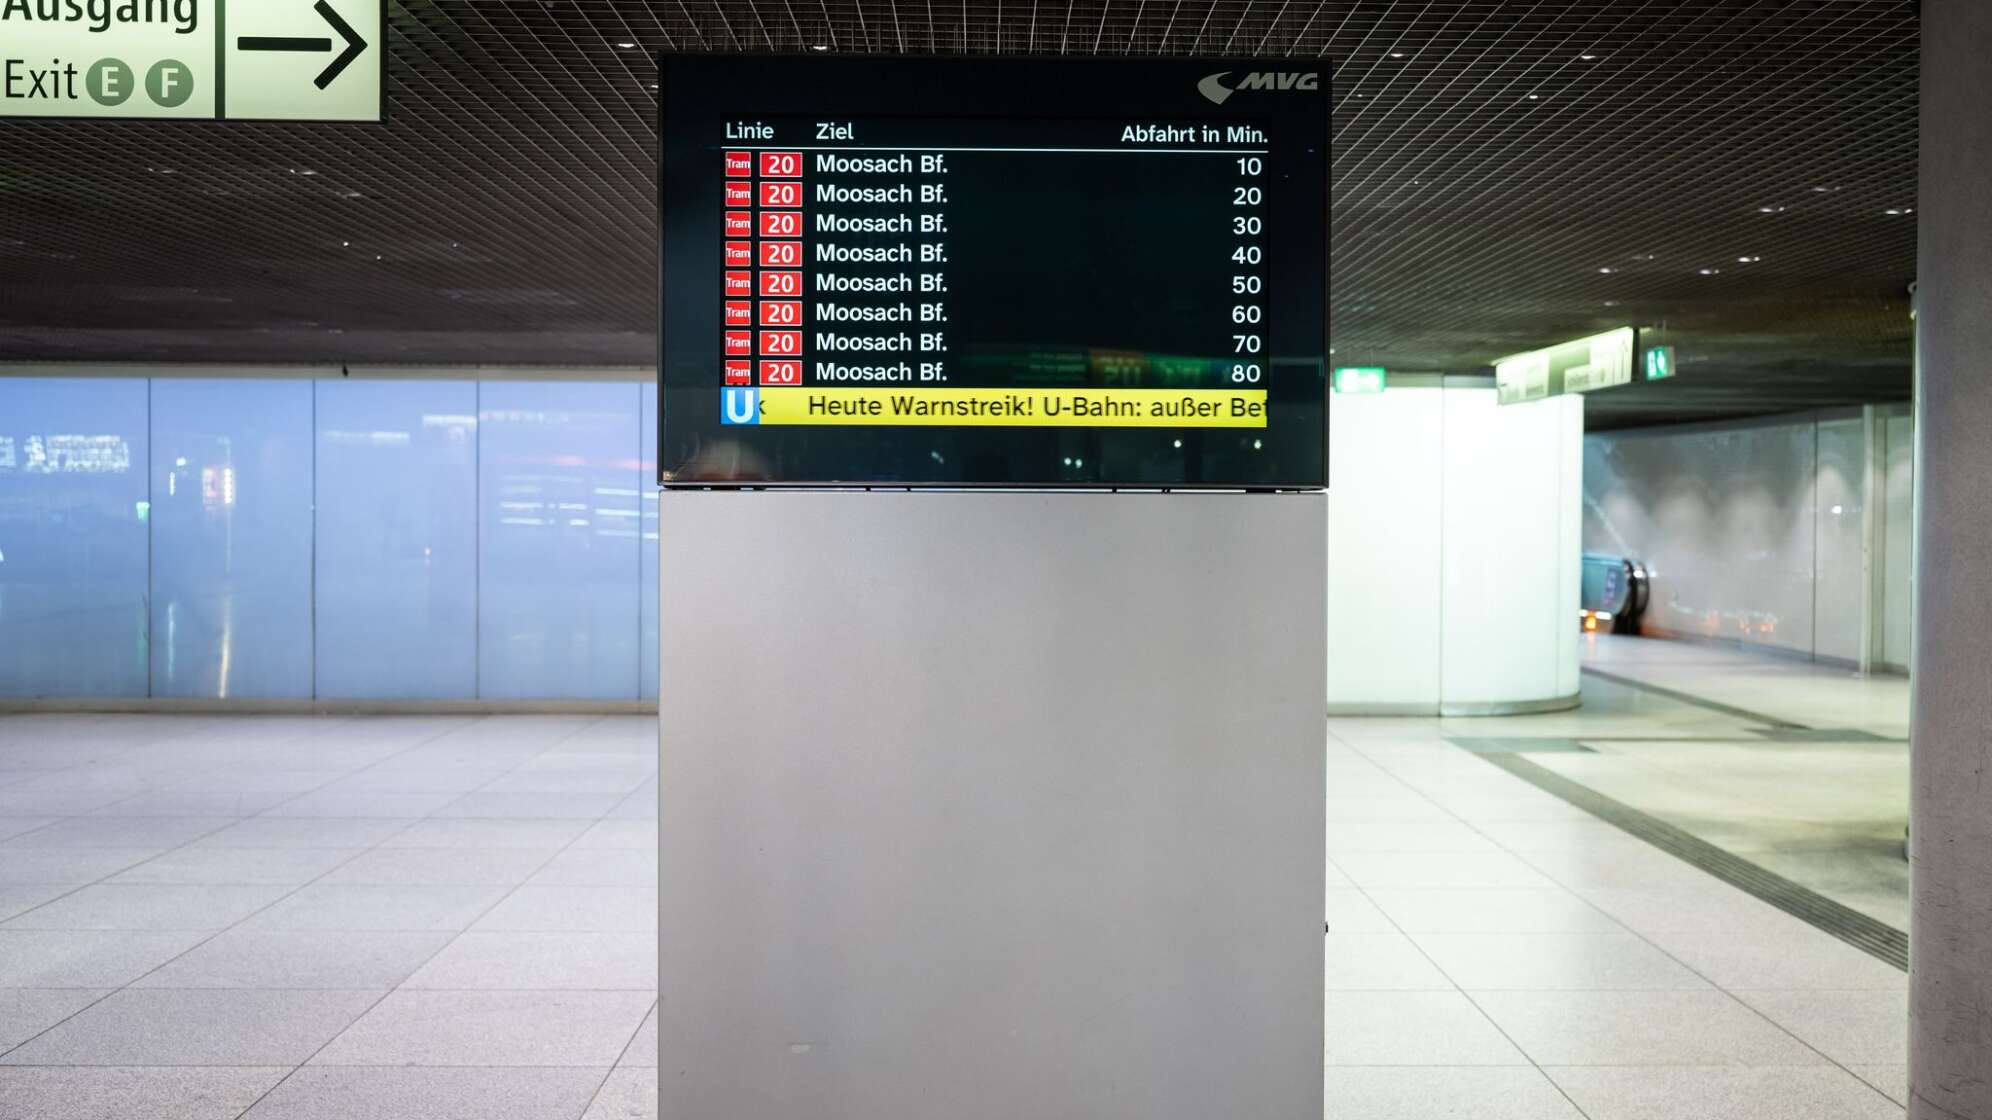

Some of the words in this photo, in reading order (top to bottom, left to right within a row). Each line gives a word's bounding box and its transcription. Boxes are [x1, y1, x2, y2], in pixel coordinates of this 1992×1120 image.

[2, 0, 198, 34] Ausgang
[5, 59, 78, 99] Exit
[101, 66, 119, 97] E
[160, 68, 179, 98] F
[1235, 72, 1318, 91] MVG
[726, 122, 775, 140] Linie
[815, 122, 855, 140] Ziel
[1121, 124, 1196, 143] Abfahrt
[1201, 124, 1220, 143] in
[1227, 125, 1268, 143] Min.
[726, 158, 751, 169] Tram
[768, 155, 795, 174] 20
[816, 154, 913, 173] Moosach
[920, 154, 948, 173] Bf.
[1237, 158, 1262, 175] 10
[726, 188, 751, 199] Tram
[768, 185, 795, 204] 20
[816, 184, 913, 203] Moosach
[920, 184, 948, 203] Bf.
[1233, 187, 1262, 205] 20
[726, 218, 751, 229] Tram
[768, 215, 795, 234] 20
[816, 214, 913, 233] Moosach
[920, 214, 948, 233] Bf.
[1233, 217, 1262, 235] 30
[726, 247, 751, 258] Tram
[768, 244, 795, 263] 20
[816, 243, 913, 262] Moosach
[920, 243, 948, 262] Bf.
[1232, 246, 1262, 264] 40
[726, 277, 751, 288] Tram
[768, 274, 795, 293] 20
[816, 273, 913, 292] Moosach
[920, 273, 948, 292] Bf.
[1232, 276, 1262, 294] 50
[726, 307, 751, 318] Tram
[768, 304, 795, 323] 20
[816, 303, 913, 322] Moosach
[920, 303, 948, 322] Bf.
[1232, 306, 1261, 324] 60
[726, 336, 751, 347] Tram
[768, 333, 795, 352] 20
[816, 332, 913, 351] Moosach
[920, 332, 948, 351] Bf.
[1232, 335, 1261, 353] 70
[726, 366, 751, 377] Tram
[768, 363, 795, 382] 20
[816, 362, 913, 381] Moosach
[920, 362, 948, 381] Bf.
[1232, 365, 1261, 383] 80
[808, 395, 883, 416] Heute
[890, 395, 1033, 417] Warnstreik!
[1043, 396, 1142, 417] U-Bahn:
[1150, 396, 1222, 418] außer
